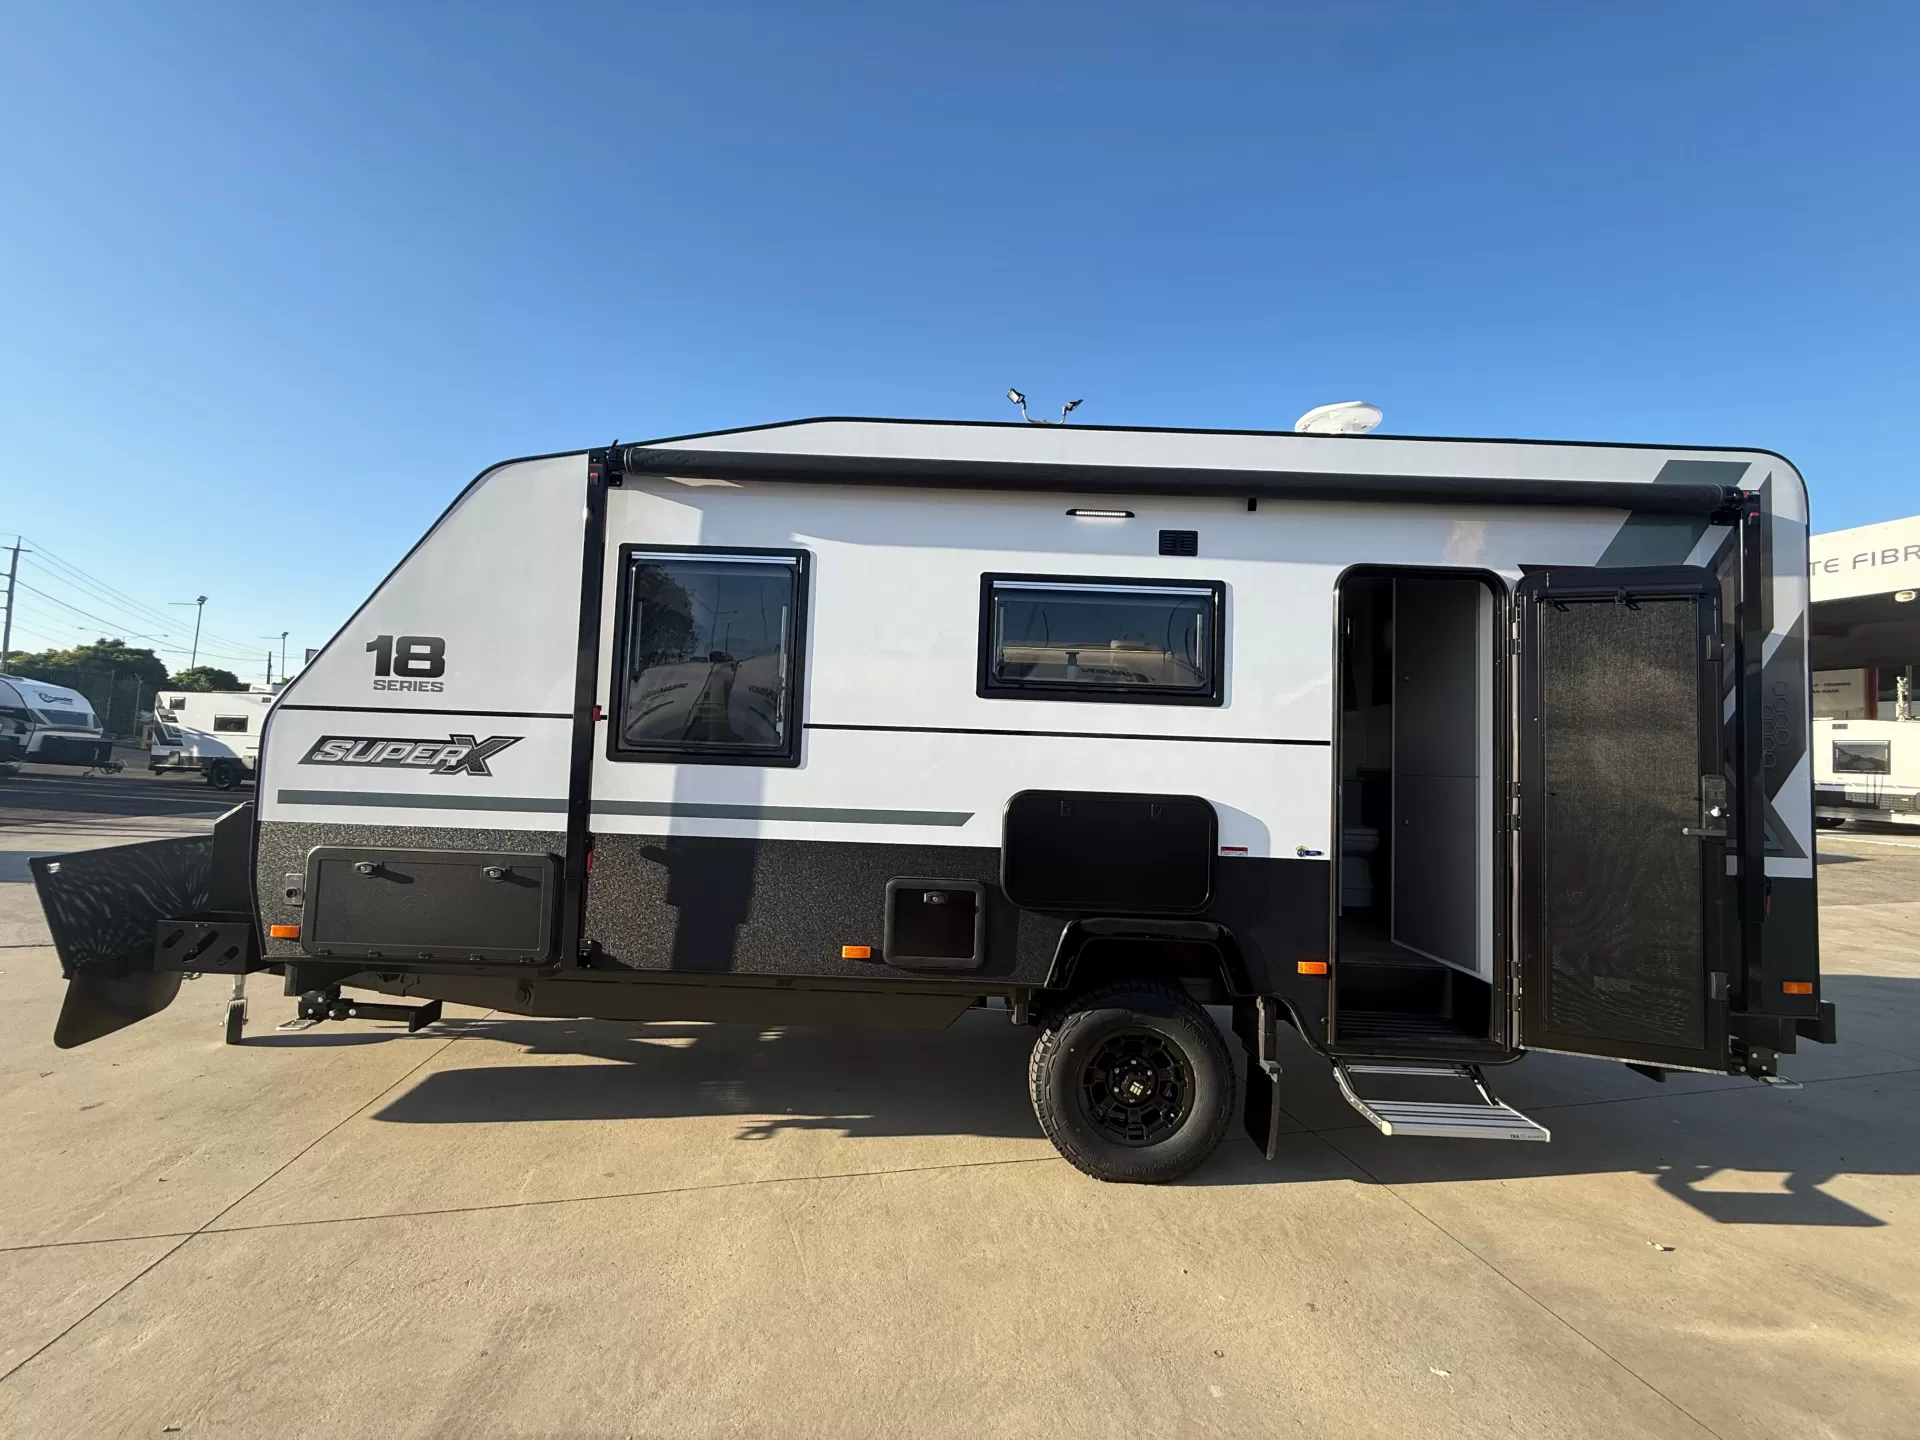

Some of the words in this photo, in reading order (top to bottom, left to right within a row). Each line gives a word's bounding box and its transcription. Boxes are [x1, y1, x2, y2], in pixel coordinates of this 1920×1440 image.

[1852, 544, 1920, 570] FIBR
[366, 634, 446, 678] 18
[373, 679, 444, 693] SERIES
